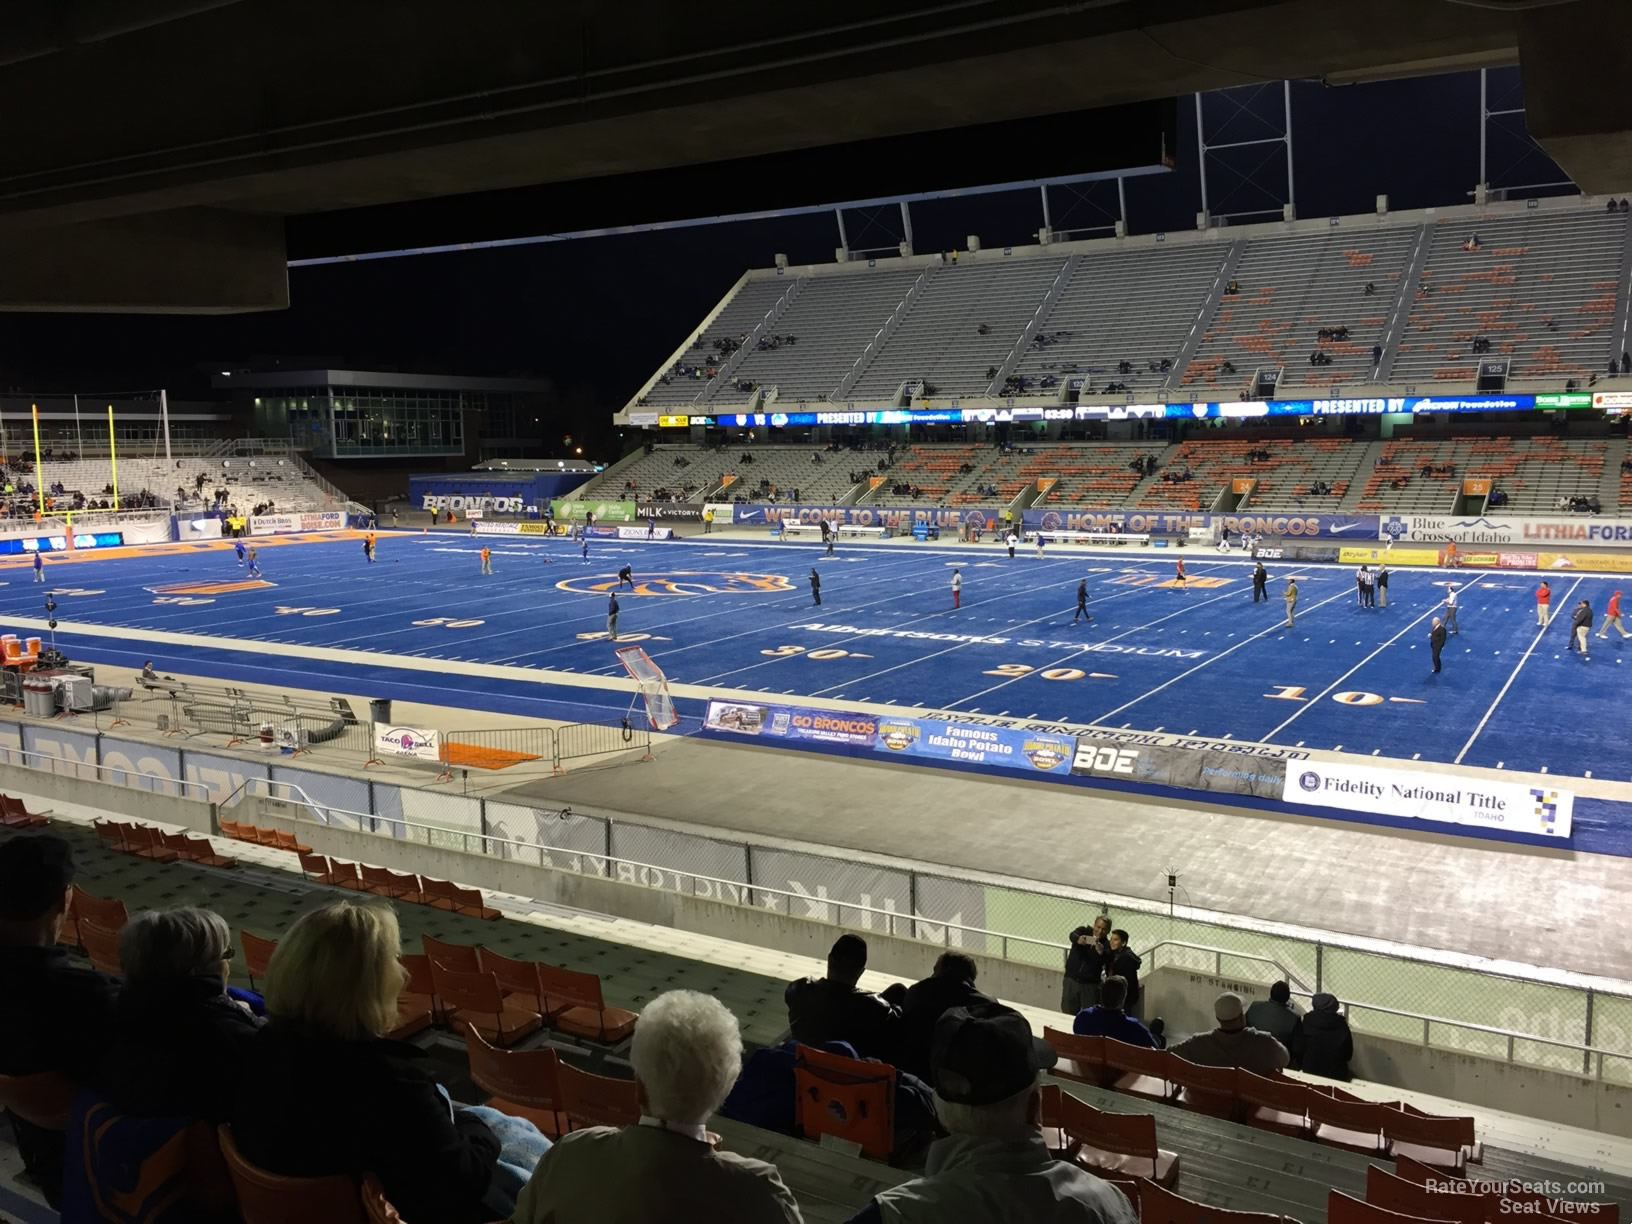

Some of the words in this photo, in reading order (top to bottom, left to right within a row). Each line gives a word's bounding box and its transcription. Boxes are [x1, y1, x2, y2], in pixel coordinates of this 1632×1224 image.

[1488, 365, 1503, 373] 125
[1264, 373, 1277, 381] 124
[1312, 399, 1385, 414] PRESENTED
[1388, 399, 1405, 412] BY
[1460, 400, 1517, 409] Foundation
[817, 412, 865, 424] PRESENTED
[422, 495, 523, 512] BRONCOS
[300, 512, 340, 521] LITHIAFORD
[637, 507, 662, 517] MILK
[763, 507, 847, 525] WELCOME
[849, 509, 873, 524] TO
[877, 510, 910, 525] THE
[915, 510, 960, 527] BLUE
[301, 520, 341, 529] BOISE.COM
[1066, 514, 1125, 530] HOME
[1129, 515, 1159, 532] OF
[1163, 515, 1203, 531] THE
[1412, 517, 1445, 530] Blue
[1411, 530, 1452, 542] Cross
[1454, 531, 1468, 542] of
[1472, 531, 1511, 543] Idaho
[1523, 523, 1632, 541] LITHIAFOR
[1256, 548, 1283, 558] BOE
[411, 617, 486, 628] 50
[788, 623, 1011, 644] Albertsons
[1016, 639, 1207, 660] STADIUM
[760, 645, 849, 660] 30
[981, 663, 1086, 681] 20
[1263, 684, 1385, 706] 10
[792, 715, 812, 728] GO
[813, 716, 876, 735] BRONCOS
[381, 735, 401, 744] TACO
[820, 729, 836, 737] VALLEY
[946, 726, 998, 741] Famous
[928, 735, 966, 748] Idaho
[969, 739, 1013, 755] Potato
[952, 748, 985, 761] Bowl
[1033, 756, 1057, 764] BOWL
[1073, 745, 1139, 773] BOE
[1202, 766, 1256, 781] performing
[1258, 772, 1284, 785] daily
[1323, 777, 1385, 798] Fidelity
[1391, 784, 1461, 804] National
[1466, 792, 1506, 811] Title
[1474, 811, 1505, 822] IDAHO
[1208, 979, 1256, 995] STANDING
